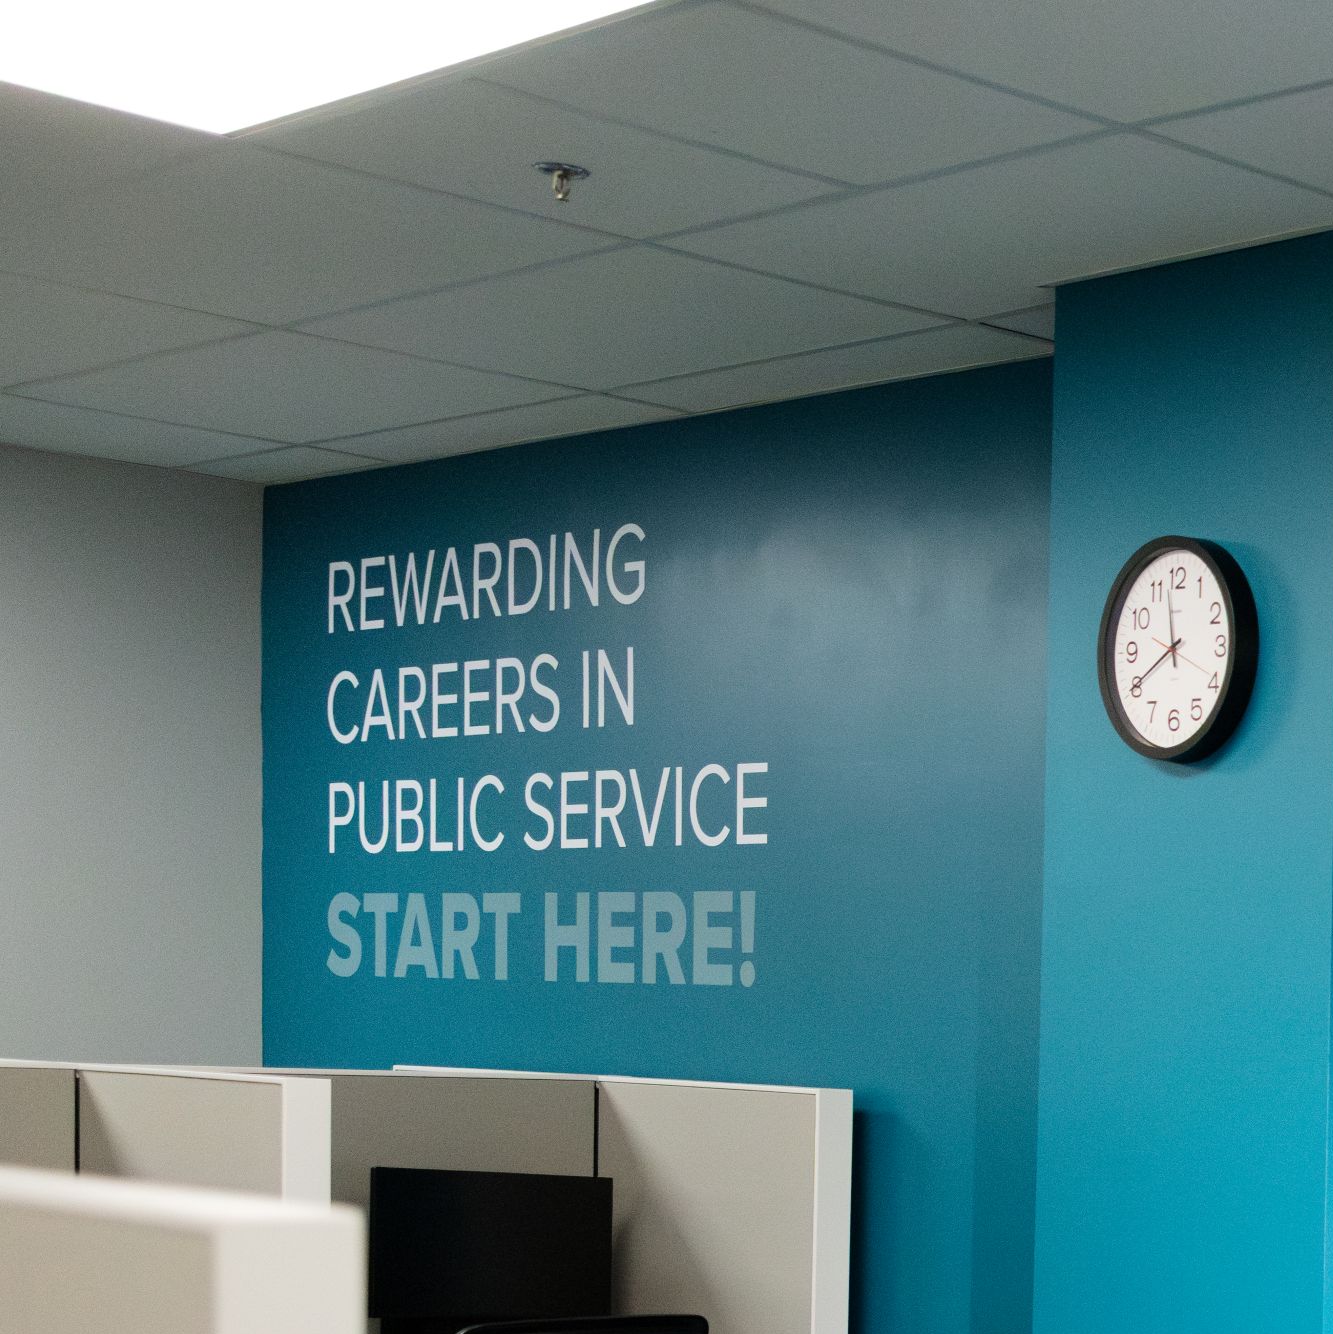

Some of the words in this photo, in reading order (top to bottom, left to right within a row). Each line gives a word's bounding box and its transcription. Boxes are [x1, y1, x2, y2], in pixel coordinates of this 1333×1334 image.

[328, 523, 646, 634] REWARDING
[1170, 567, 1186, 589] 12
[1197, 576, 1202, 598] 1
[1150, 580, 1162, 602] 11
[1132, 607, 1150, 630] 10
[1210, 602, 1221, 624] 2
[1126, 641, 1138, 663] 9
[1215, 635, 1226, 657] 3
[1131, 676, 1142, 697] 8
[1208, 672, 1219, 693] 4
[327, 653, 560, 744] CAREERS
[582, 647, 634, 728] IN
[1147, 701, 1157, 723] 7
[1168, 709, 1180, 731] 6
[1191, 699, 1202, 720] 5
[328, 775, 505, 854] PUBLIC
[523, 762, 768, 851] SERVICE
[326, 892, 521, 981] START
[544, 891, 756, 987] HERE!
